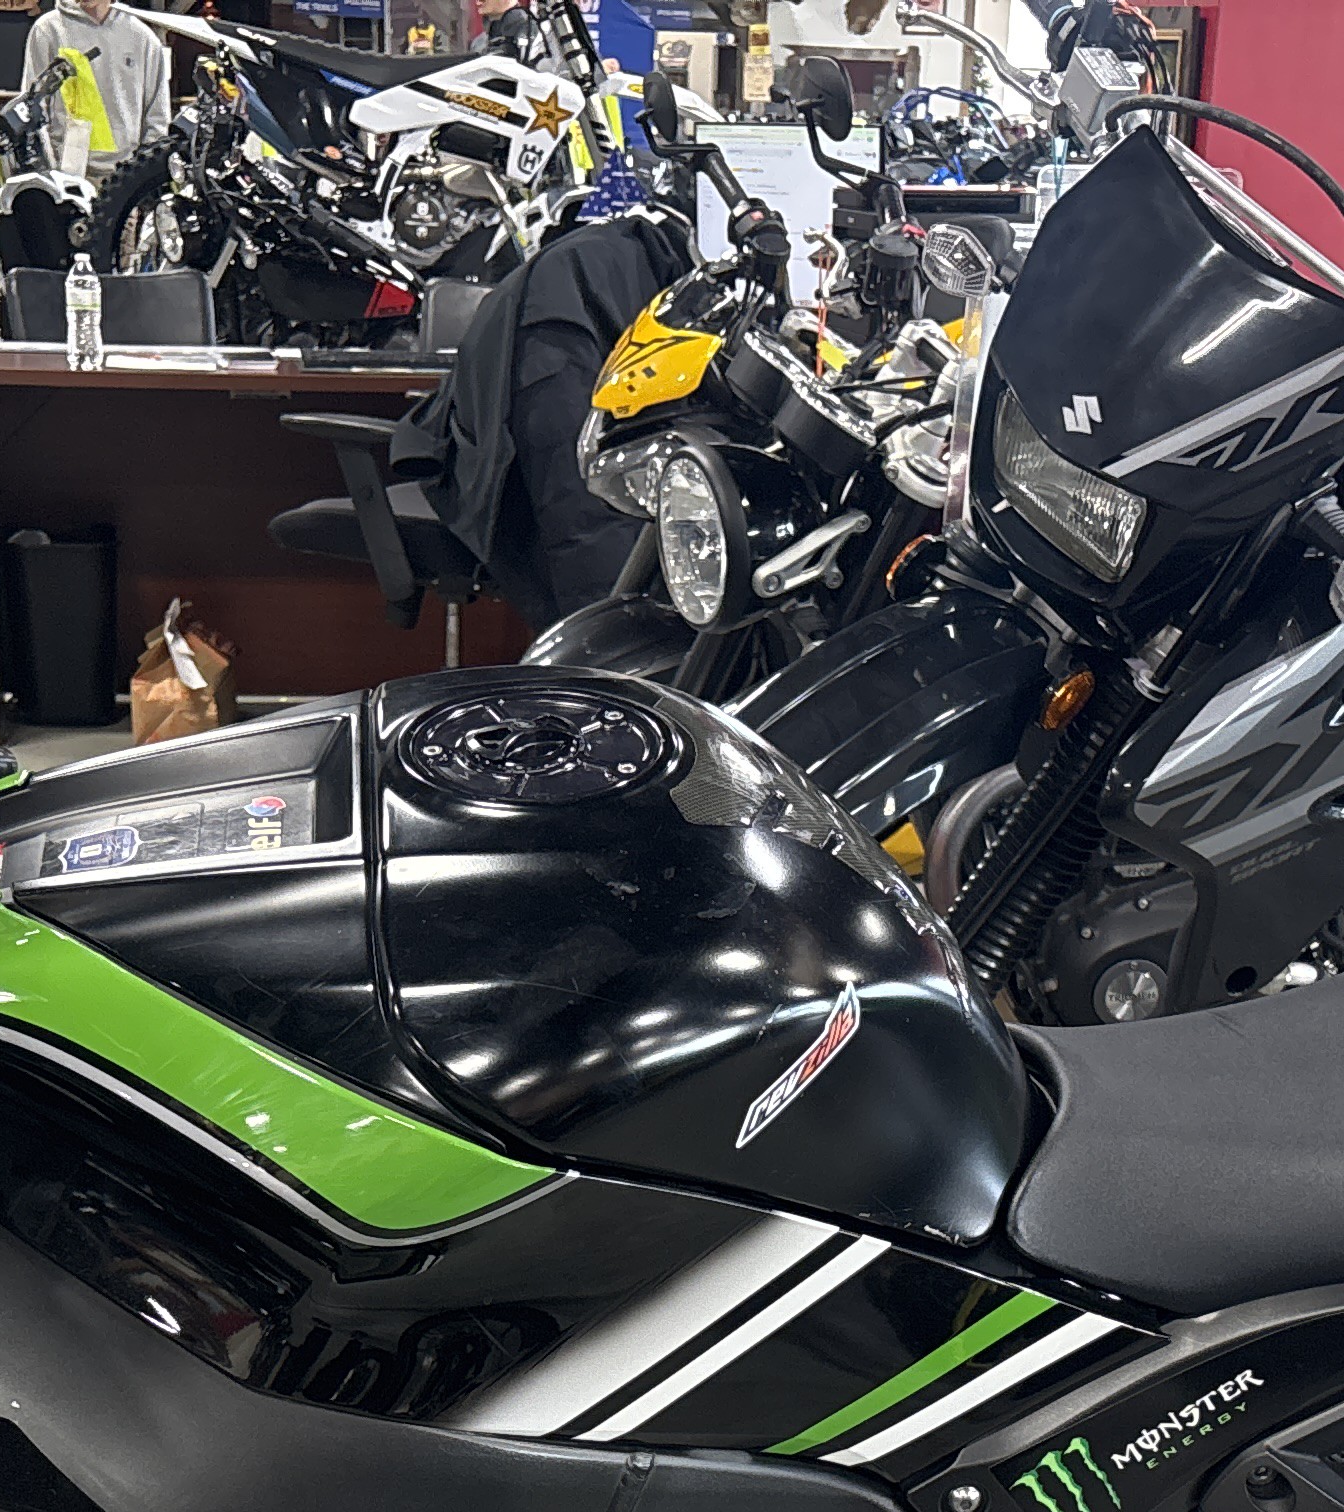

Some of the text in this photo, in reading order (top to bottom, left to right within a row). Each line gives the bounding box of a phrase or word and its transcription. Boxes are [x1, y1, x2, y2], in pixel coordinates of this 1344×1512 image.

[248, 816, 282, 850] elf
[749, 1000, 855, 1132] revzilla
[1110, 1369, 1265, 1470] MONSTER
[1146, 1402, 1247, 1470] ENERGY
